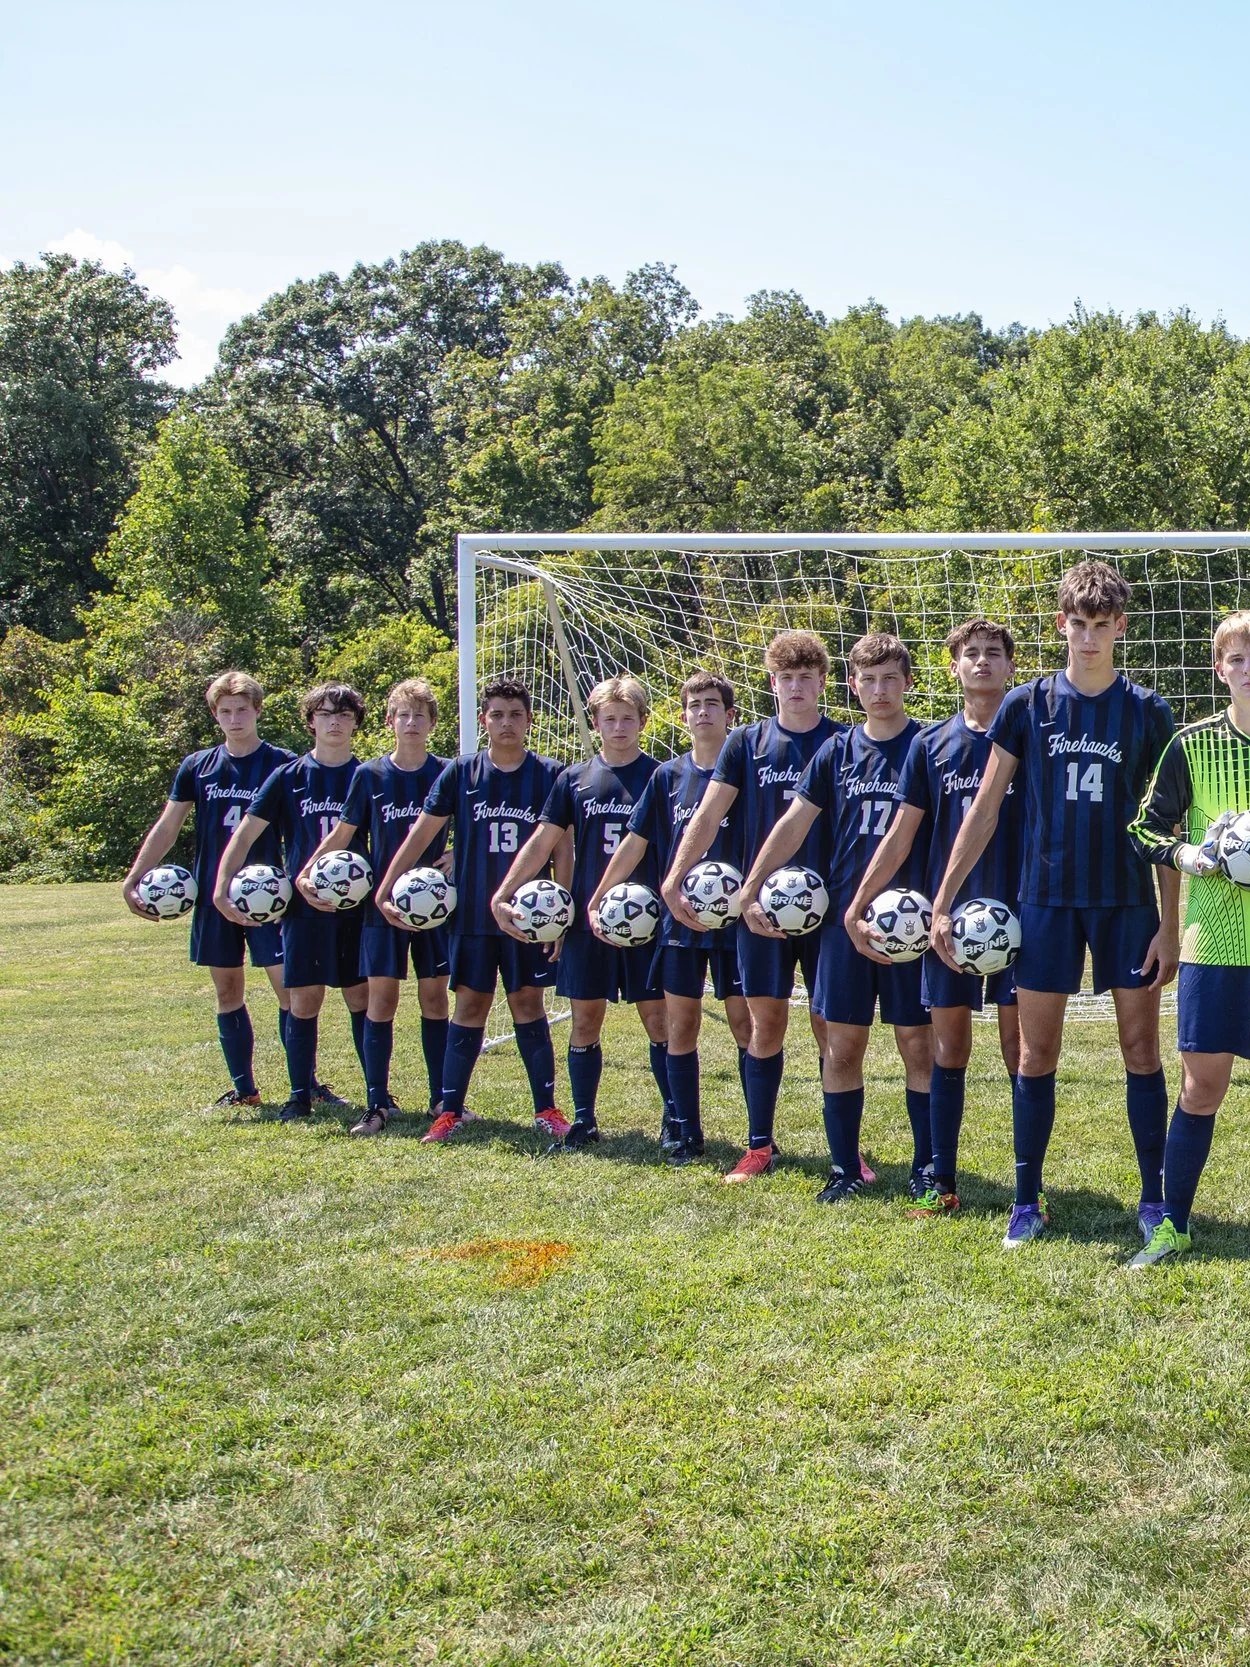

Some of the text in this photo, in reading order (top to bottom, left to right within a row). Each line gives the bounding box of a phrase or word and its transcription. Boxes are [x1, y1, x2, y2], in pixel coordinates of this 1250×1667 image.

[1048, 731, 1122, 763] Firehawks
[757, 764, 801, 787] Fireha
[845, 774, 899, 799] Firehaw
[943, 768, 1015, 795] Firehs
[1066, 762, 1104, 802] 14
[205, 782, 259, 801] Firehawk
[301, 796, 344, 817] Firehaw
[381, 801, 422, 823] Fireha
[473, 800, 537, 824] Firehawks
[583, 796, 634, 819] Firehaw
[673, 801, 729, 827] Firehs
[859, 800, 893, 836] 17
[223, 805, 241, 833] 4
[489, 822, 519, 853] 13
[603, 823, 622, 854] 5
[149, 885, 186, 898] BRINE
[241, 881, 280, 893] BRINE
[314, 877, 351, 893] BRINE
[409, 880, 447, 897] BRINE
[769, 895, 813, 906] BRINE
[531, 913, 569, 924] BRINE
[885, 939, 929, 951] BRINE
[963, 934, 1009, 955] BRINE
